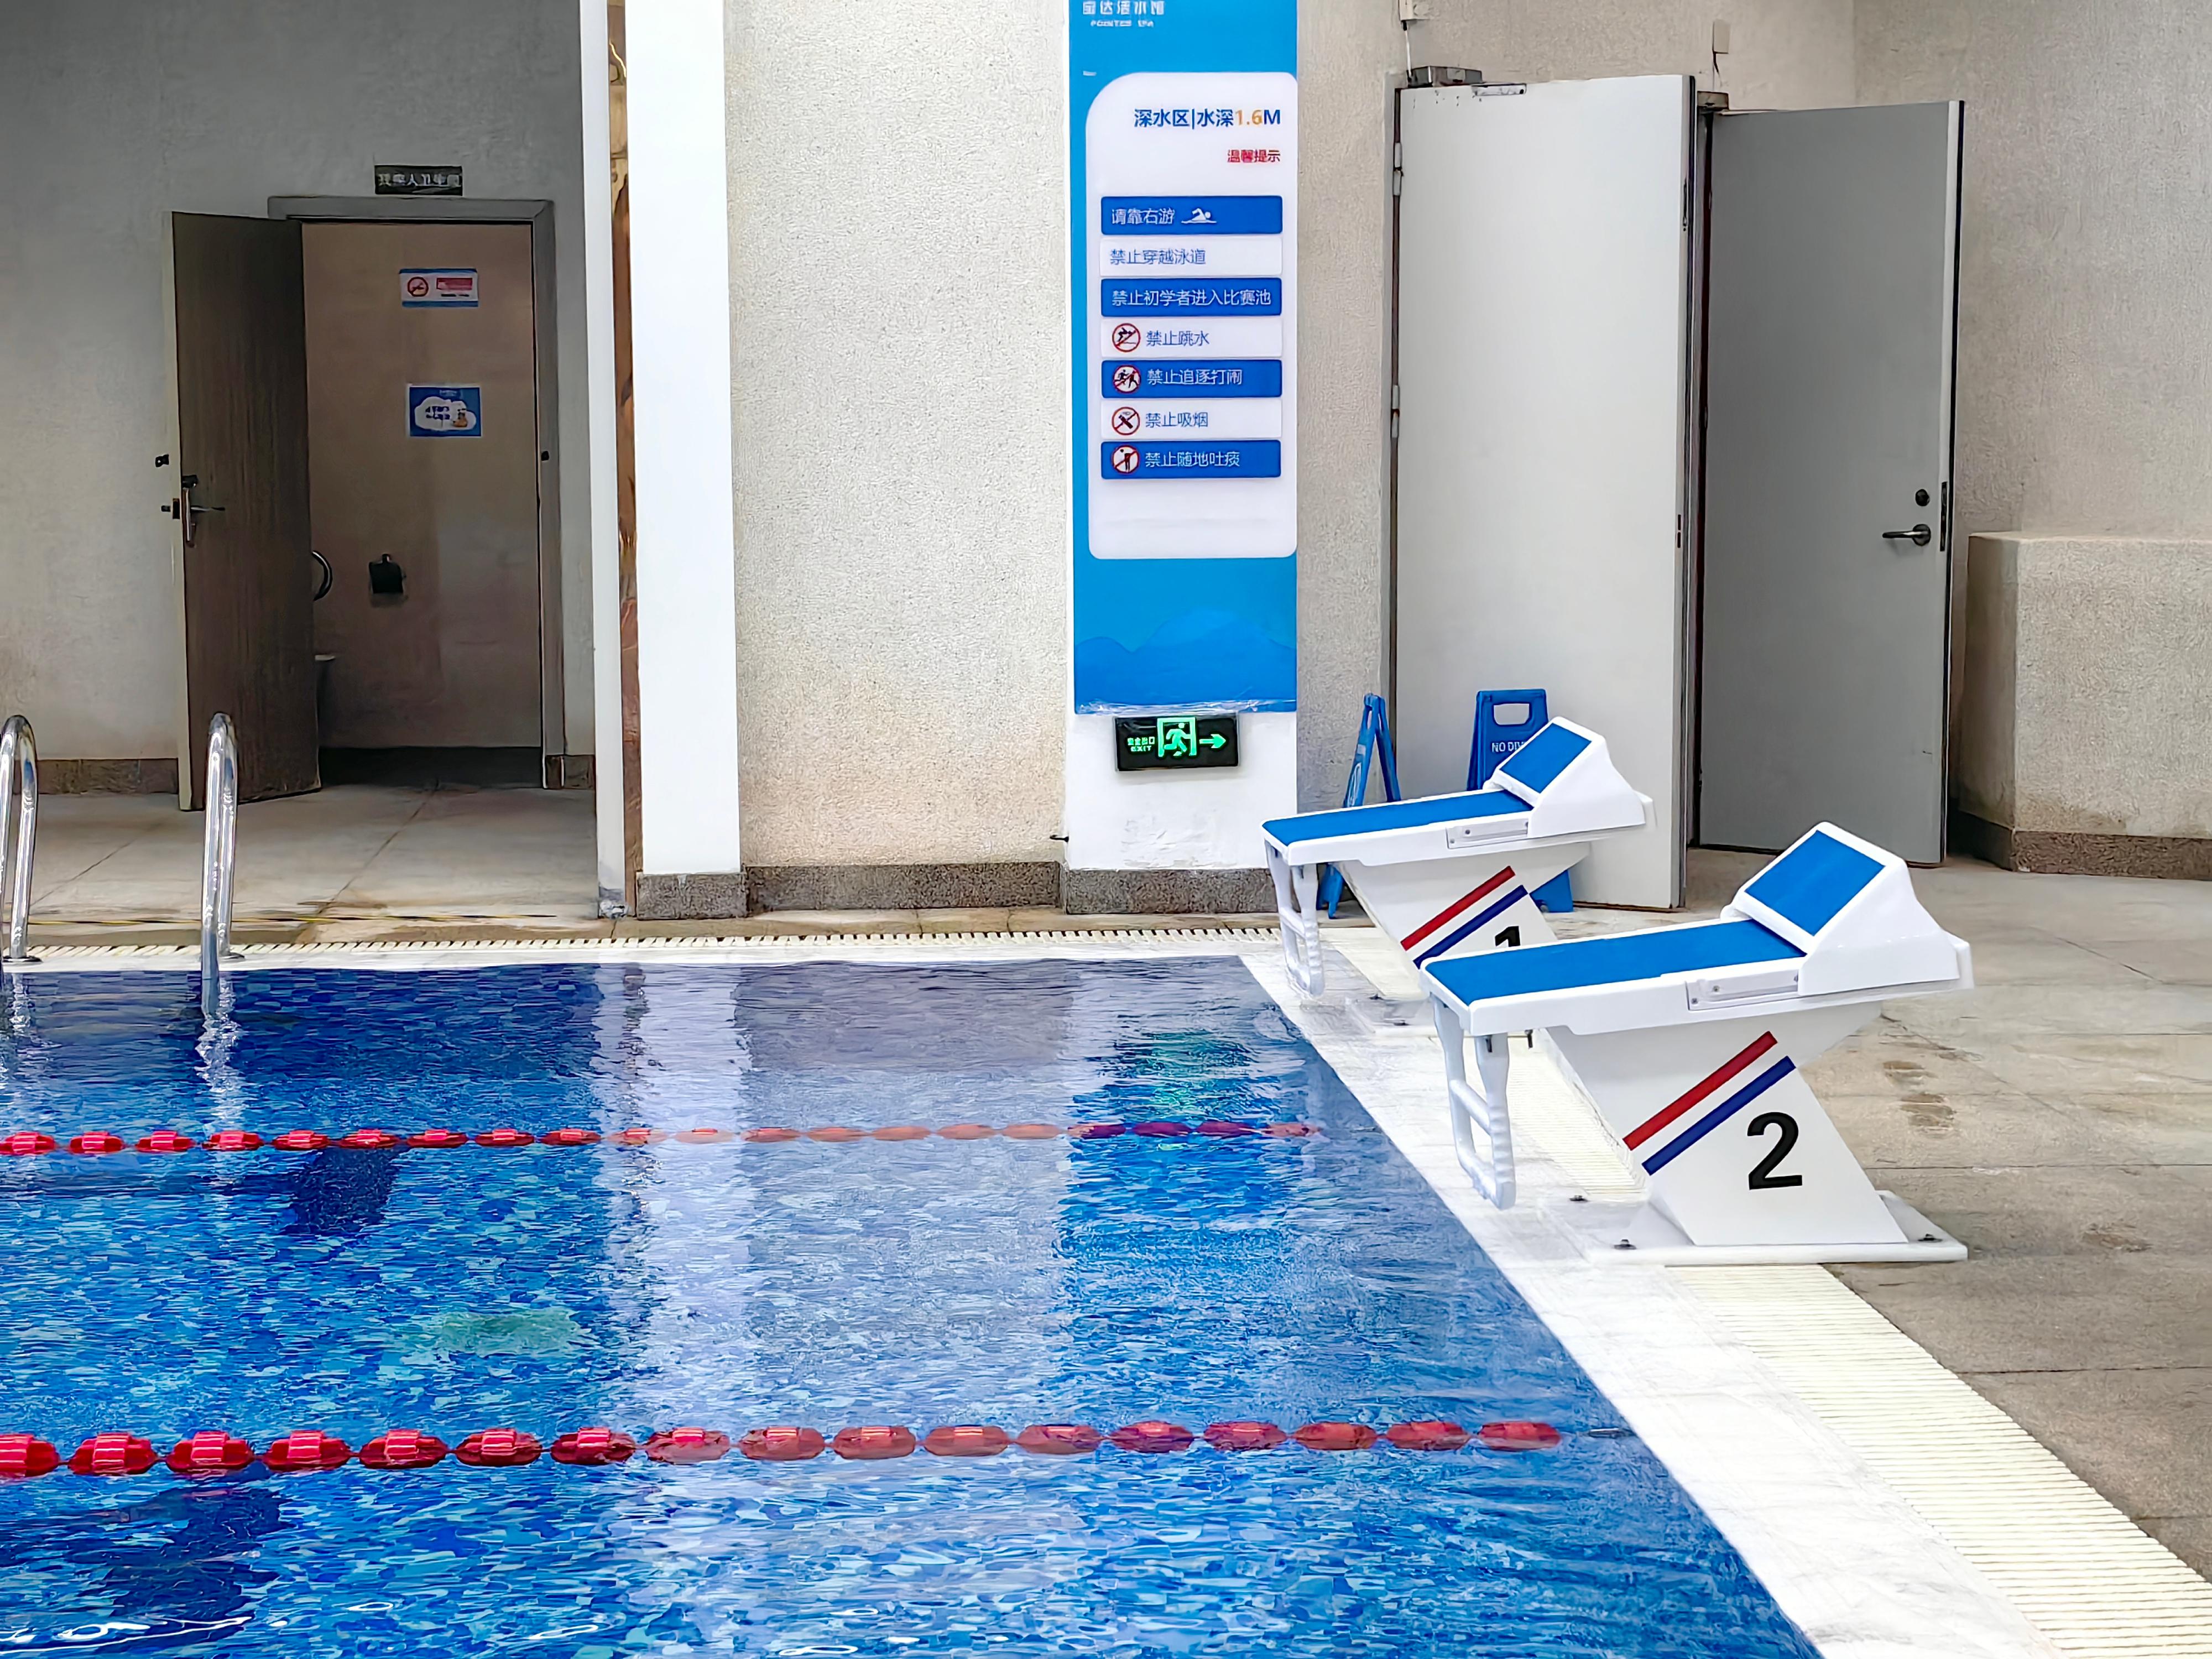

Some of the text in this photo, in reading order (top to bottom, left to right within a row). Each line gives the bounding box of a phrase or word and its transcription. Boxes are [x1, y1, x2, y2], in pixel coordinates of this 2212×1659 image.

[1227, 149, 1281, 163] 温馨提示
[1111, 207, 1175, 225] 请靠右游
[1110, 248, 1206, 265] 禁止穿越泳道
[1112, 289, 1271, 306] 禁止初学者进入比赛池
[1146, 330, 1209, 347] 禁止跳水
[1147, 368, 1243, 386] 禁止追逐打闹
[1145, 411, 1208, 428] 禁止吸烟
[1145, 451, 1240, 468] 禁止随地吐痰
[1492, 742, 1506, 753] NO
[1495, 926, 1521, 947] 1
[1747, 1112, 1802, 1190] 2
